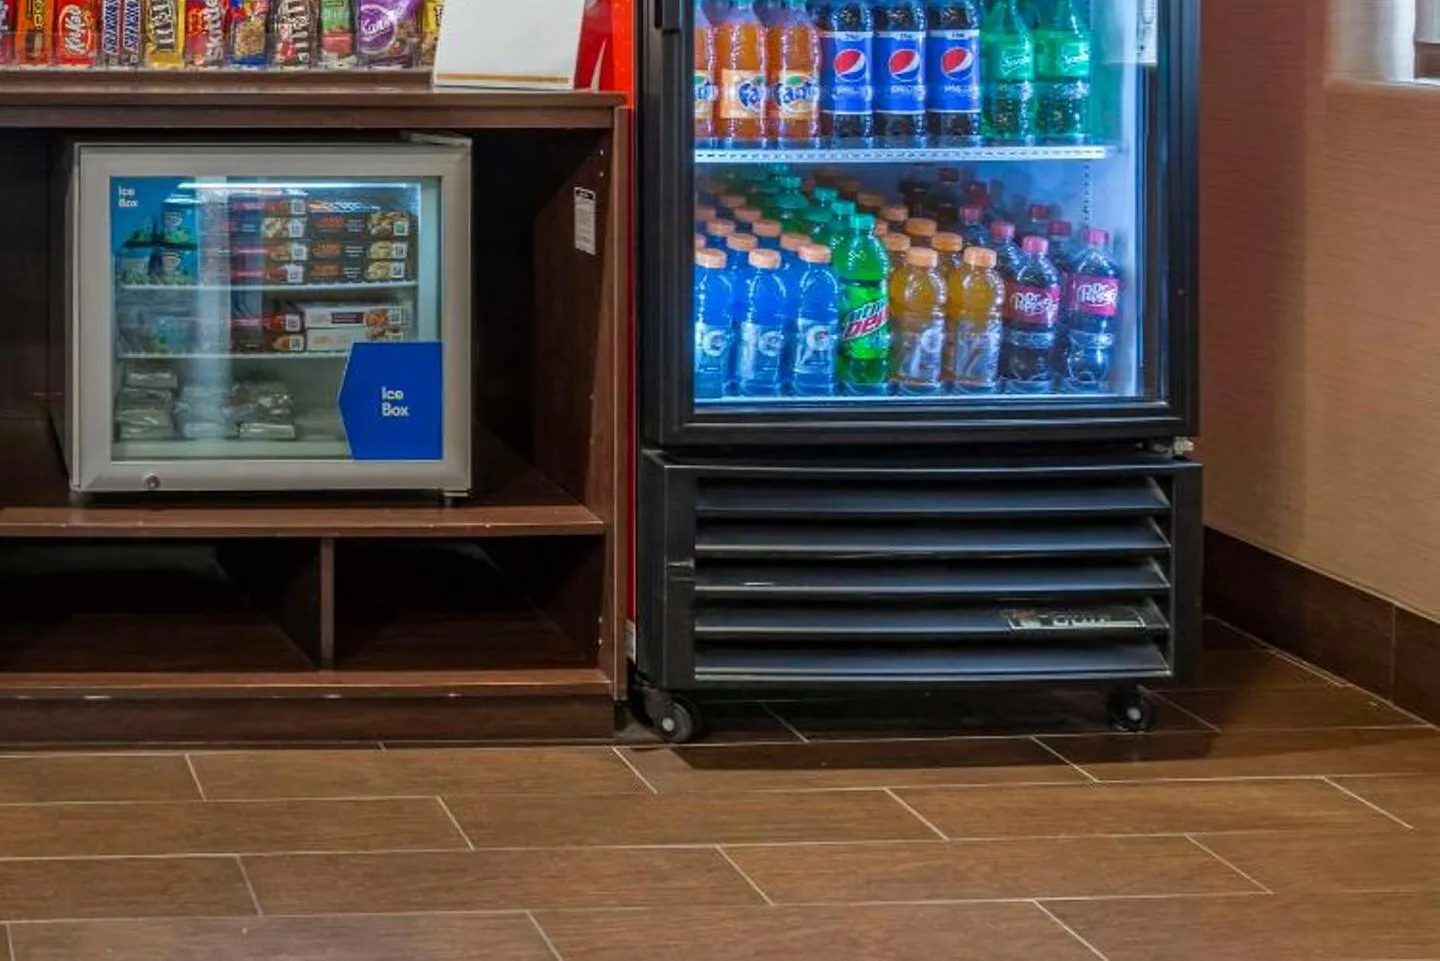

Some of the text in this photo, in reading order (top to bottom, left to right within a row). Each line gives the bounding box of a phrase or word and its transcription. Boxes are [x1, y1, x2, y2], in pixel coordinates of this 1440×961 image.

[118, 186, 135, 196] Ice
[118, 198, 139, 208] Box
[381, 386, 405, 400] Ice
[382, 402, 410, 417] Box
